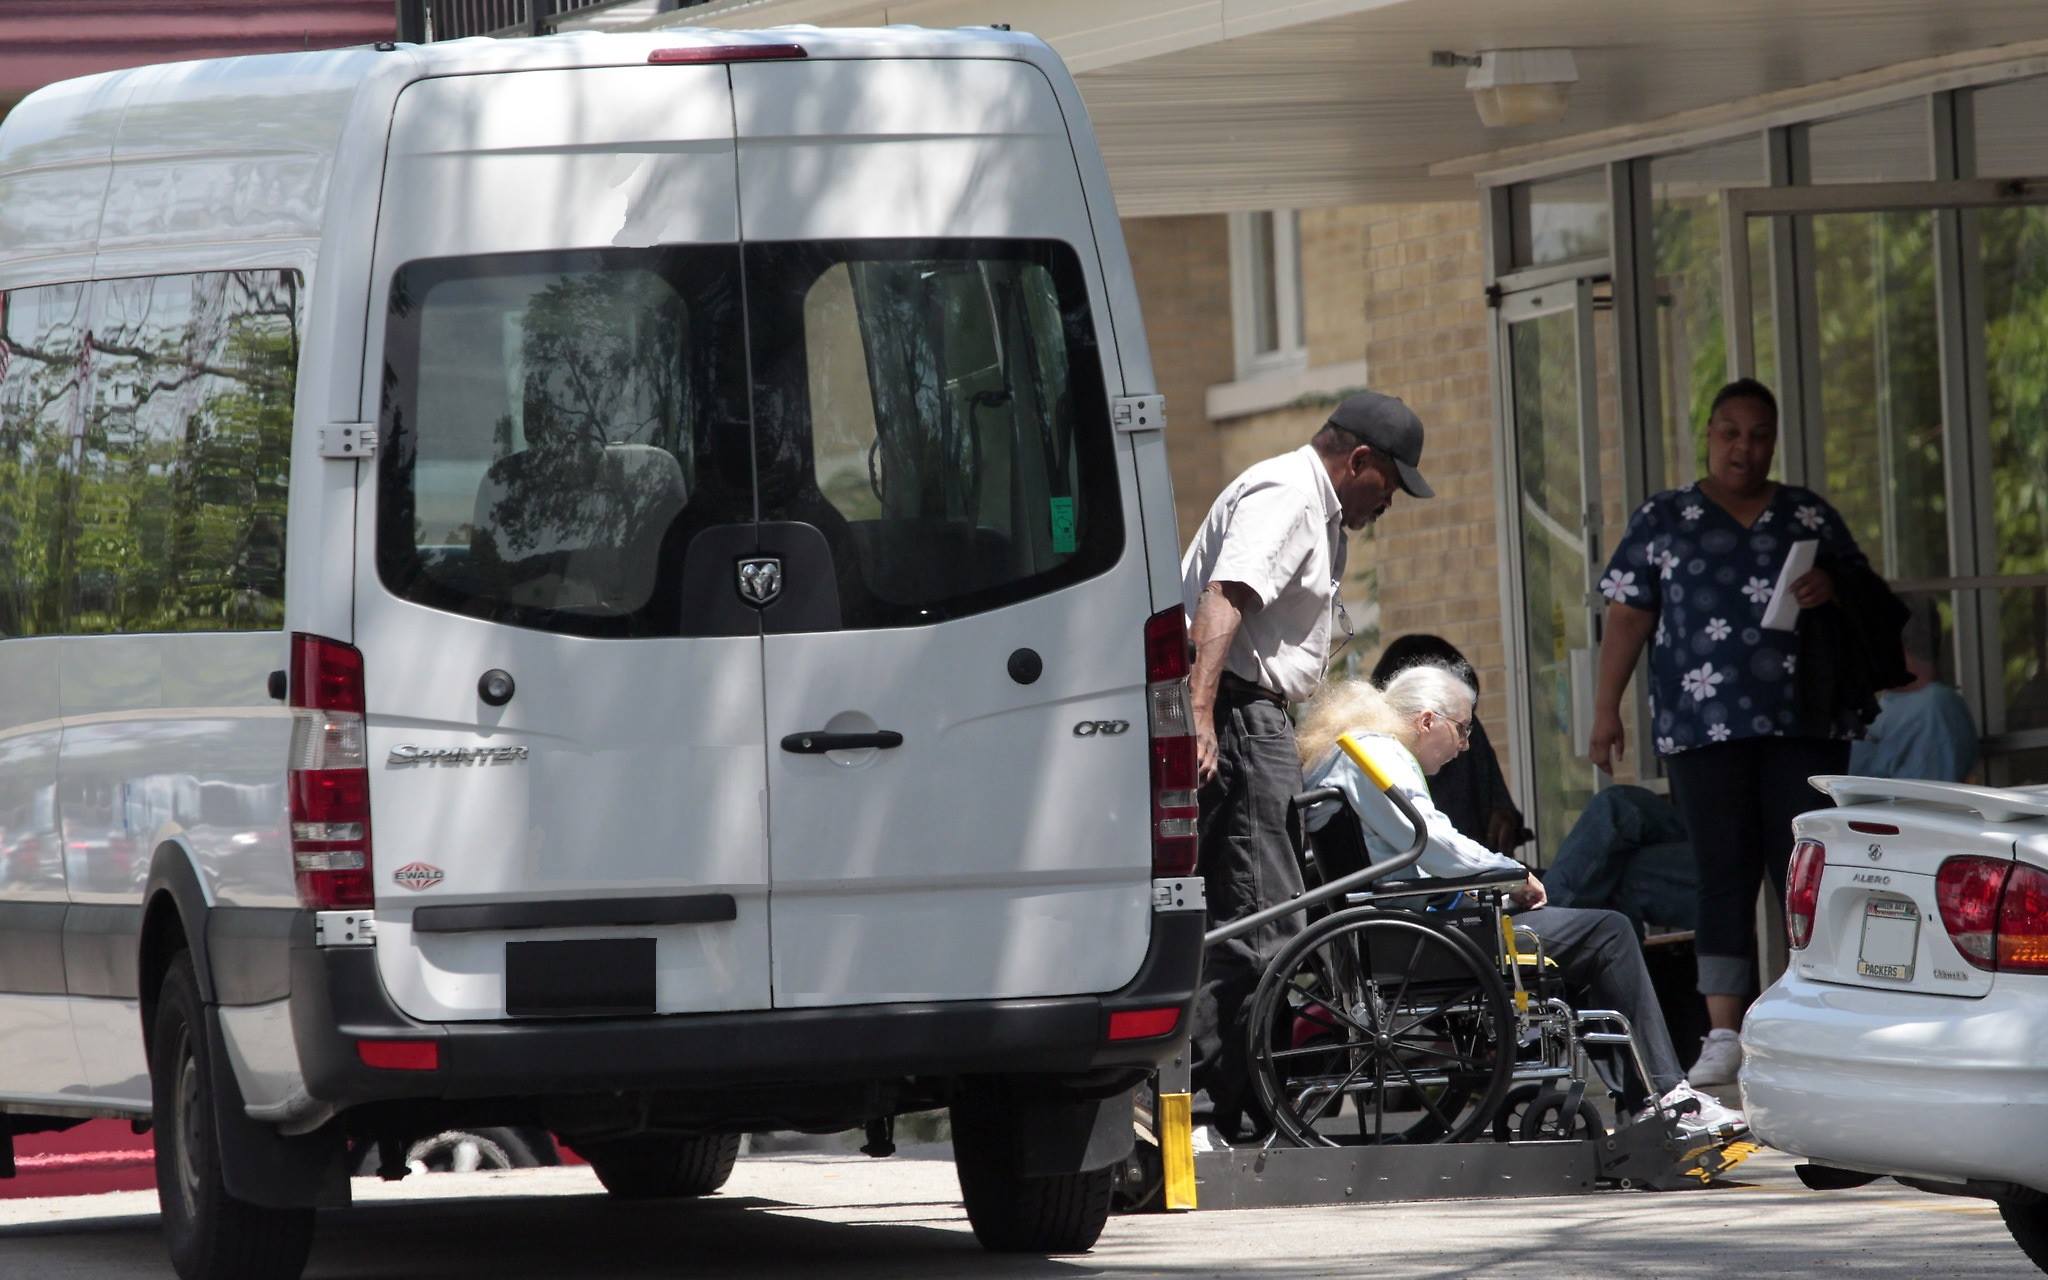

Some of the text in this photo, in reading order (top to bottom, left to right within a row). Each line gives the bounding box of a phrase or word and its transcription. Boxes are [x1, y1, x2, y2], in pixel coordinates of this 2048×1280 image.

[1073, 720, 1130, 736] CRD
[387, 743, 530, 764] SPRINTER
[394, 871, 444, 880] EWALD
[1852, 873, 1891, 886] ALERO
[1865, 963, 1898, 977] PACKERS
